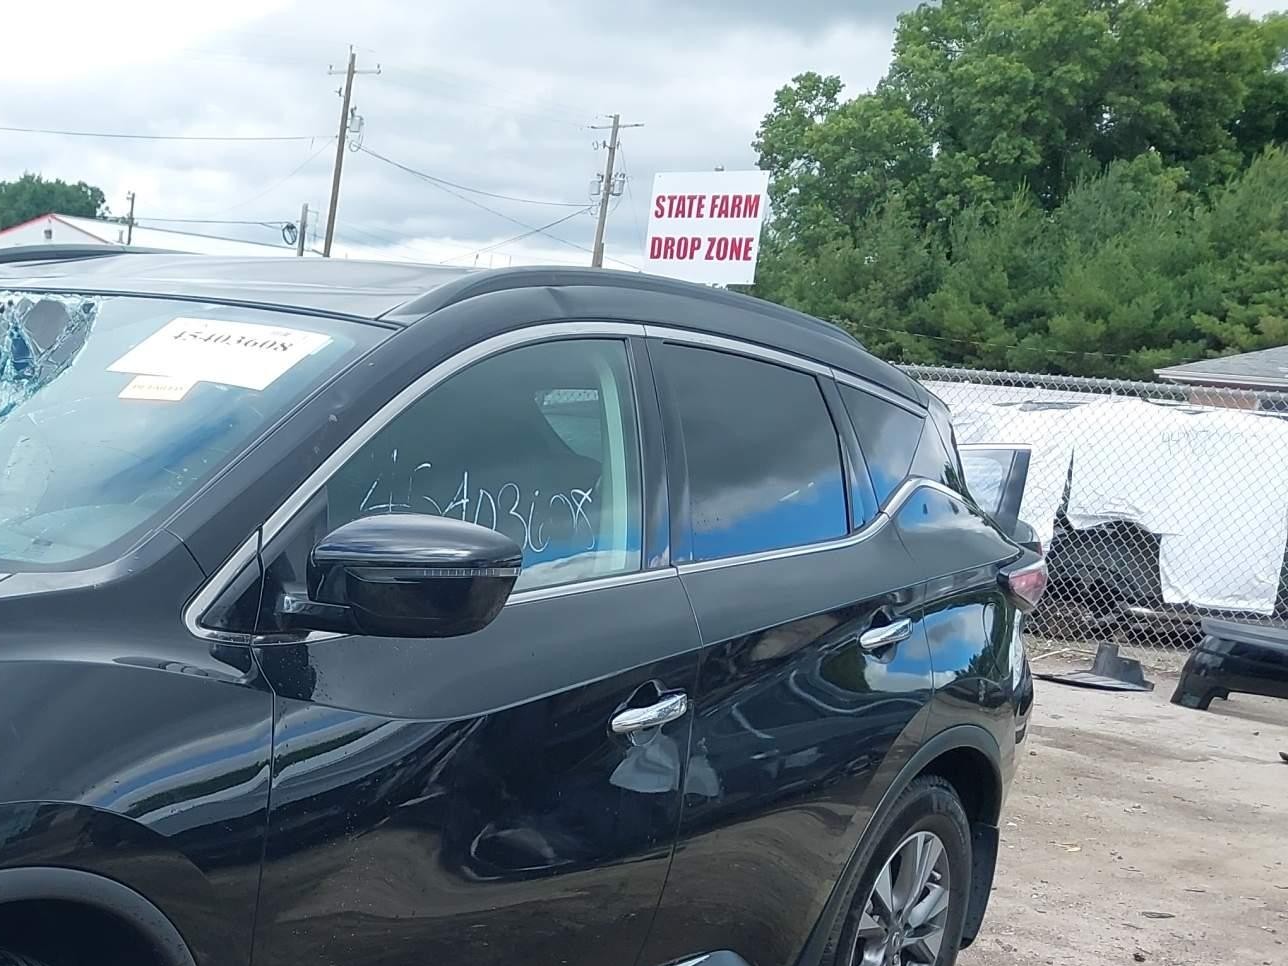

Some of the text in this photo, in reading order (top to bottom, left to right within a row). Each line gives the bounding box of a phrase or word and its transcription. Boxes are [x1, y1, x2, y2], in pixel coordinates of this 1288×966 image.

[654, 194, 761, 219] STATE FARM
[649, 236, 754, 261] DROP ZONE
[173, 330, 294, 352] 45403608
